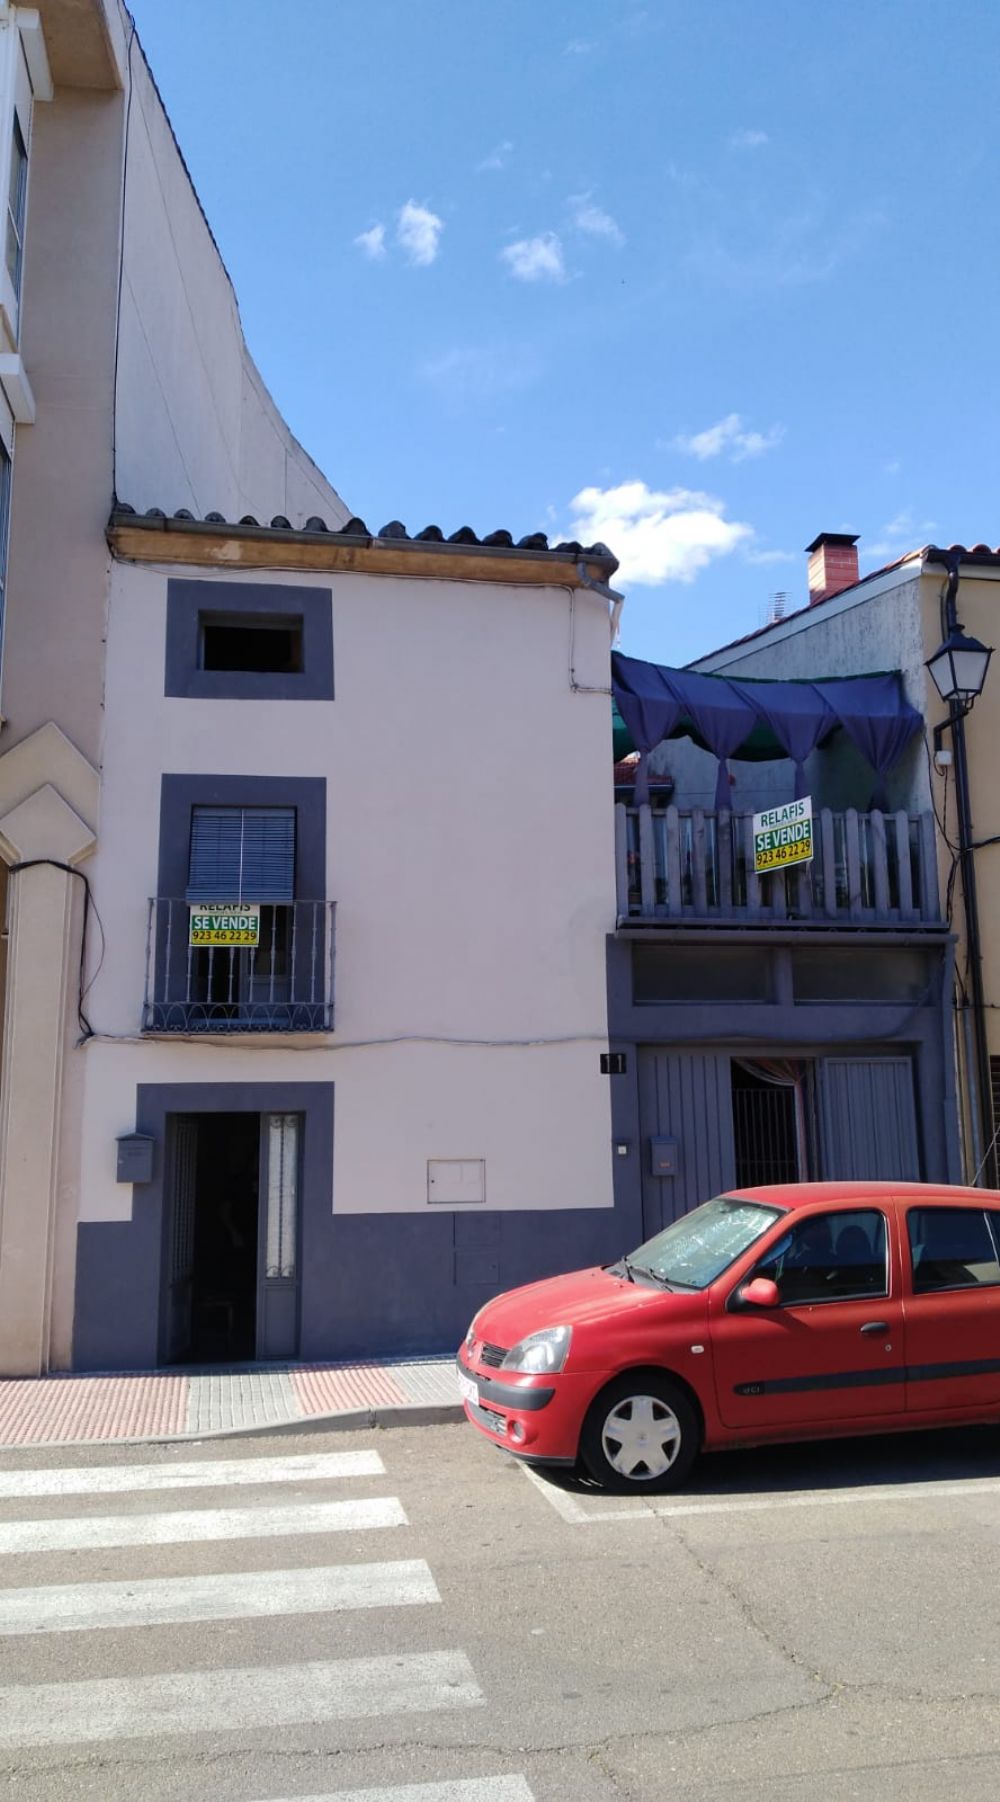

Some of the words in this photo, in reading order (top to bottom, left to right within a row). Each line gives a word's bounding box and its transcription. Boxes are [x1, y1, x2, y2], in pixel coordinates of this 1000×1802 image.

[761, 802, 804, 827] RELAFIS
[757, 833, 771, 851] SE
[772, 821, 810, 847] VENDE
[757, 851, 773, 866] 923
[776, 847, 787, 859] 46
[789, 843, 799, 857] 22
[801, 840, 810, 853] 29
[194, 916, 210, 929] SE
[212, 916, 256, 929] VENDE
[193, 931, 211, 940] 923
[214, 931, 227, 940] 46
[229, 931, 241, 940] 22
[244, 931, 257, 940] 29
[606, 1055, 622, 1073] 11
